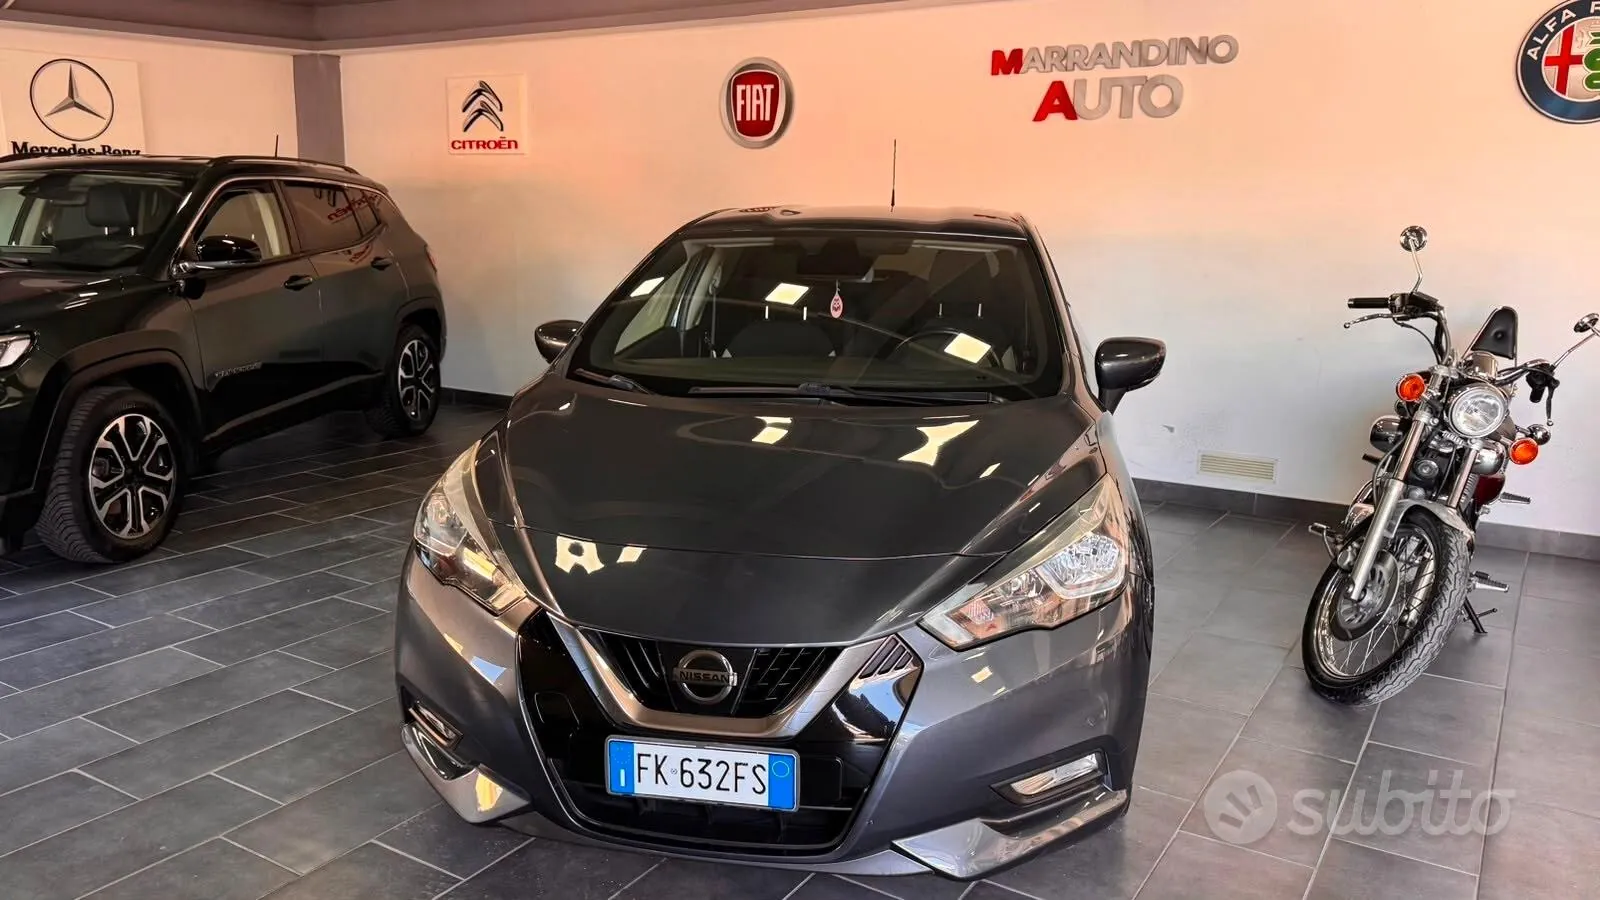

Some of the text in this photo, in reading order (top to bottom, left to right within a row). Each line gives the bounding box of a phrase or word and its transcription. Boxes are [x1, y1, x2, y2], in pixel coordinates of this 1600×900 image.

[991, 34, 1239, 76] MARRANDINO
[1526, 8, 1577, 60] ALFA
[736, 84, 775, 121] FIAT
[1032, 74, 1184, 122] AUTO
[679, 670, 730, 684] NISSAN
